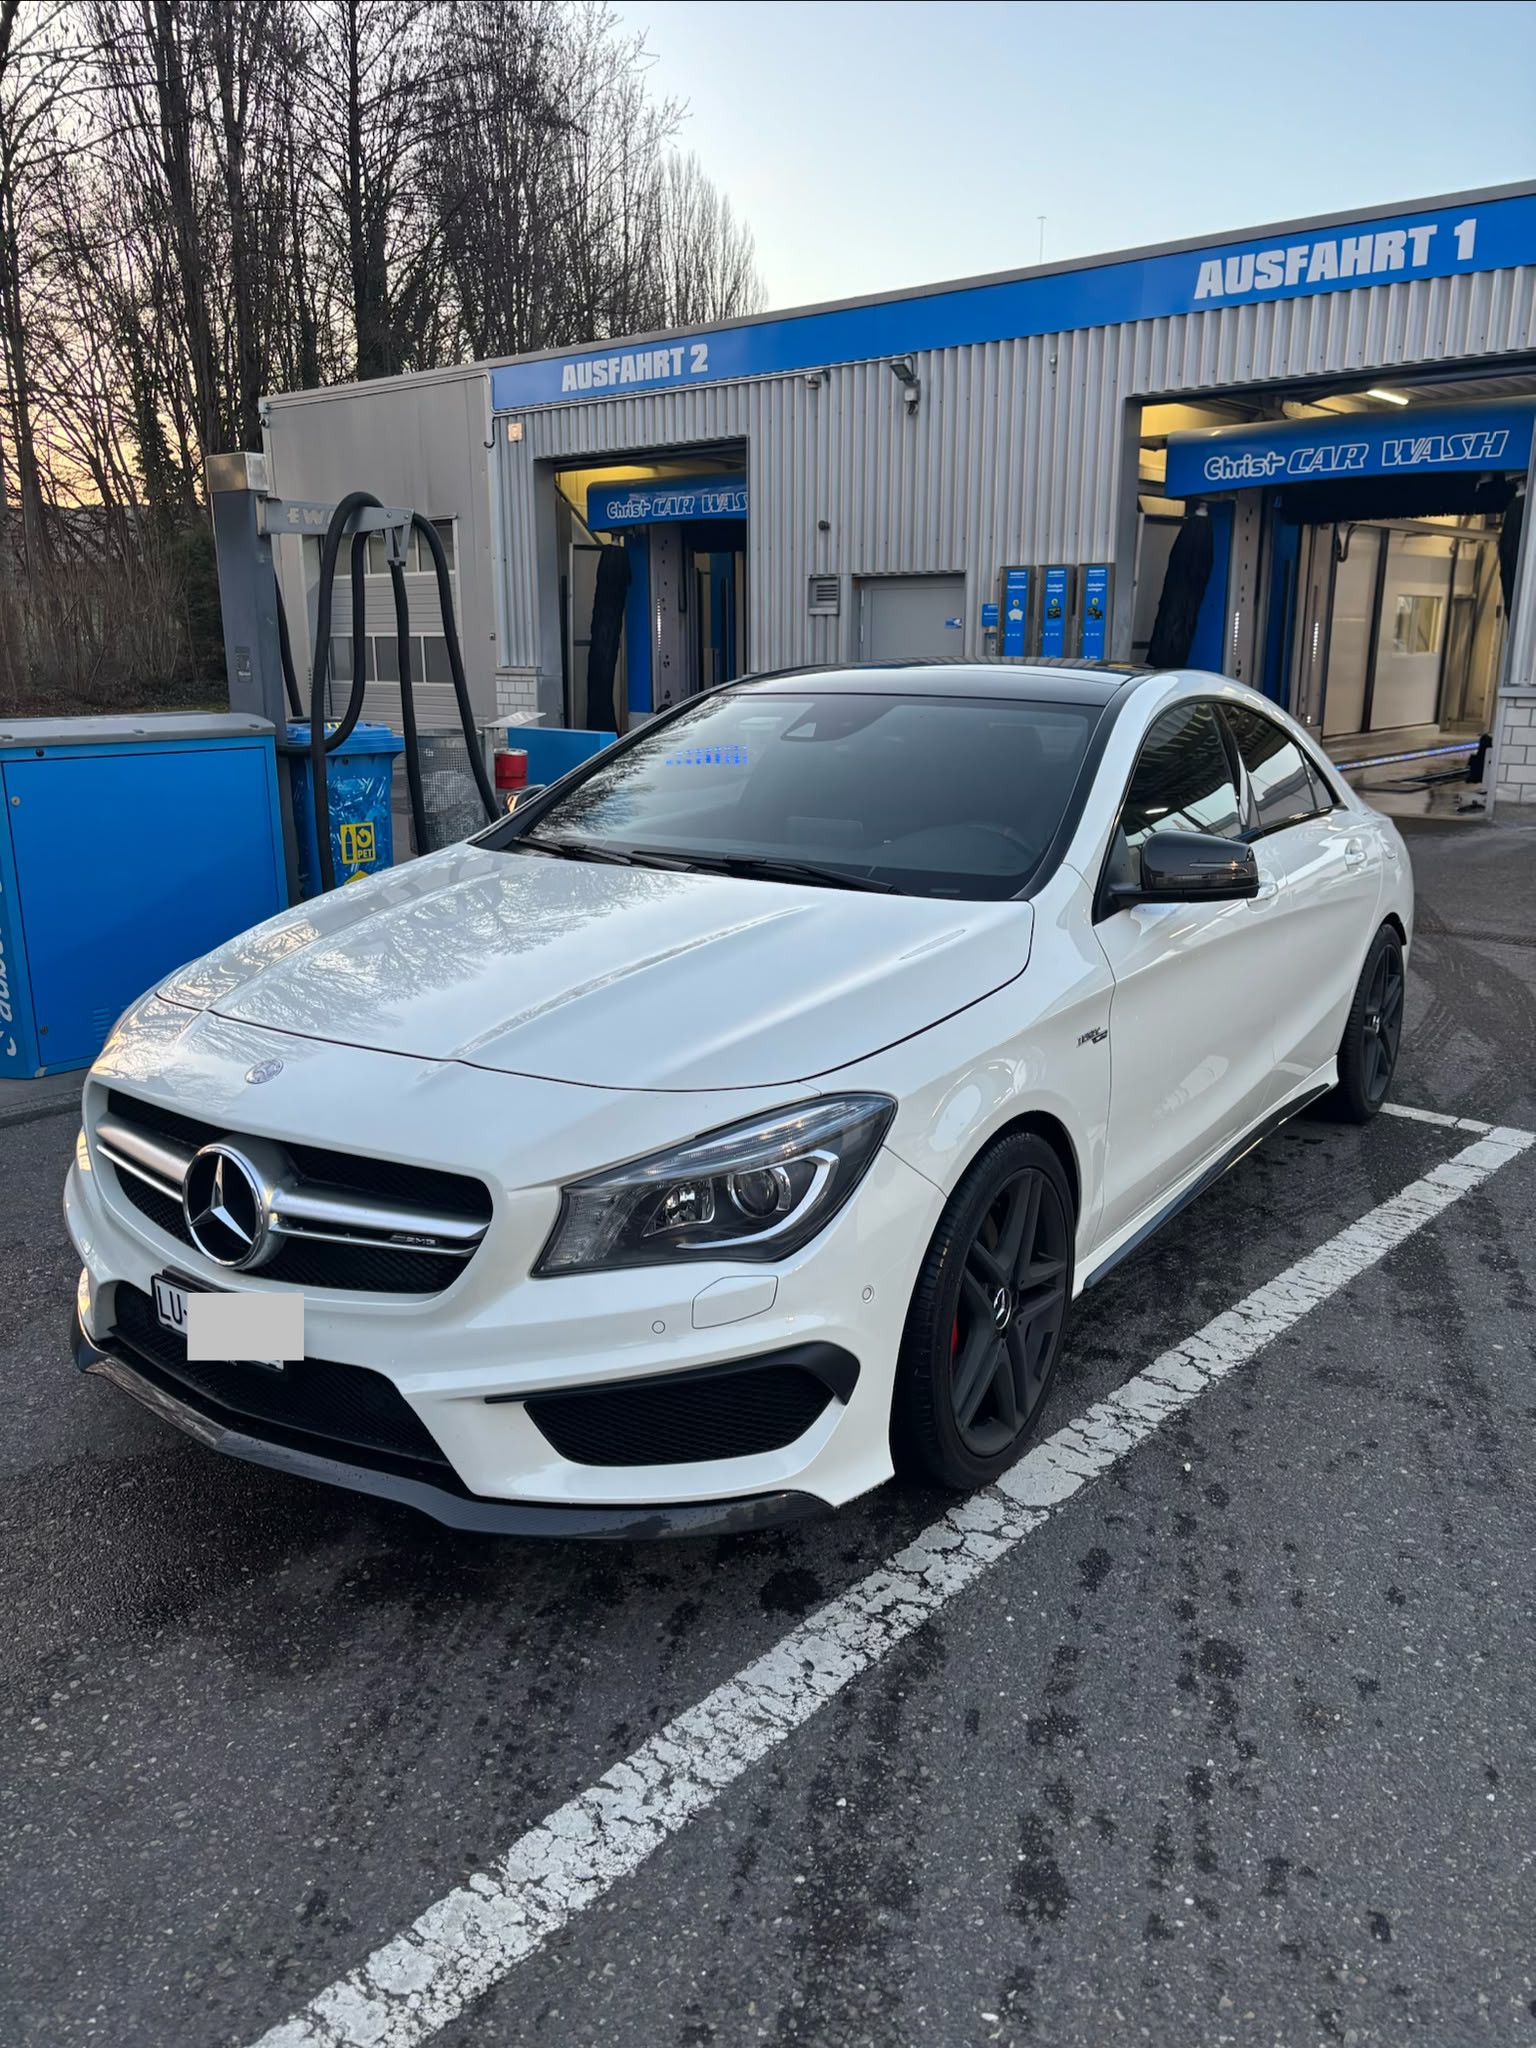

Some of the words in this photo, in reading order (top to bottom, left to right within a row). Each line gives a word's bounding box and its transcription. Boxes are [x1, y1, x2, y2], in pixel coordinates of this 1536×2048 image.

[1194, 225, 1438, 299] AUSFAHRT
[1454, 218, 1477, 260] 1
[563, 347, 685, 392] AUSFAHRT
[690, 343, 709, 373] 2
[1204, 452, 1285, 481] Christ
[1287, 444, 1369, 474] CAR
[1381, 430, 1510, 467] WASH
[606, 501, 650, 520] Christ
[652, 496, 695, 516] CAR
[702, 491, 747, 513] WAS
[357, 849, 373, 859] PET
